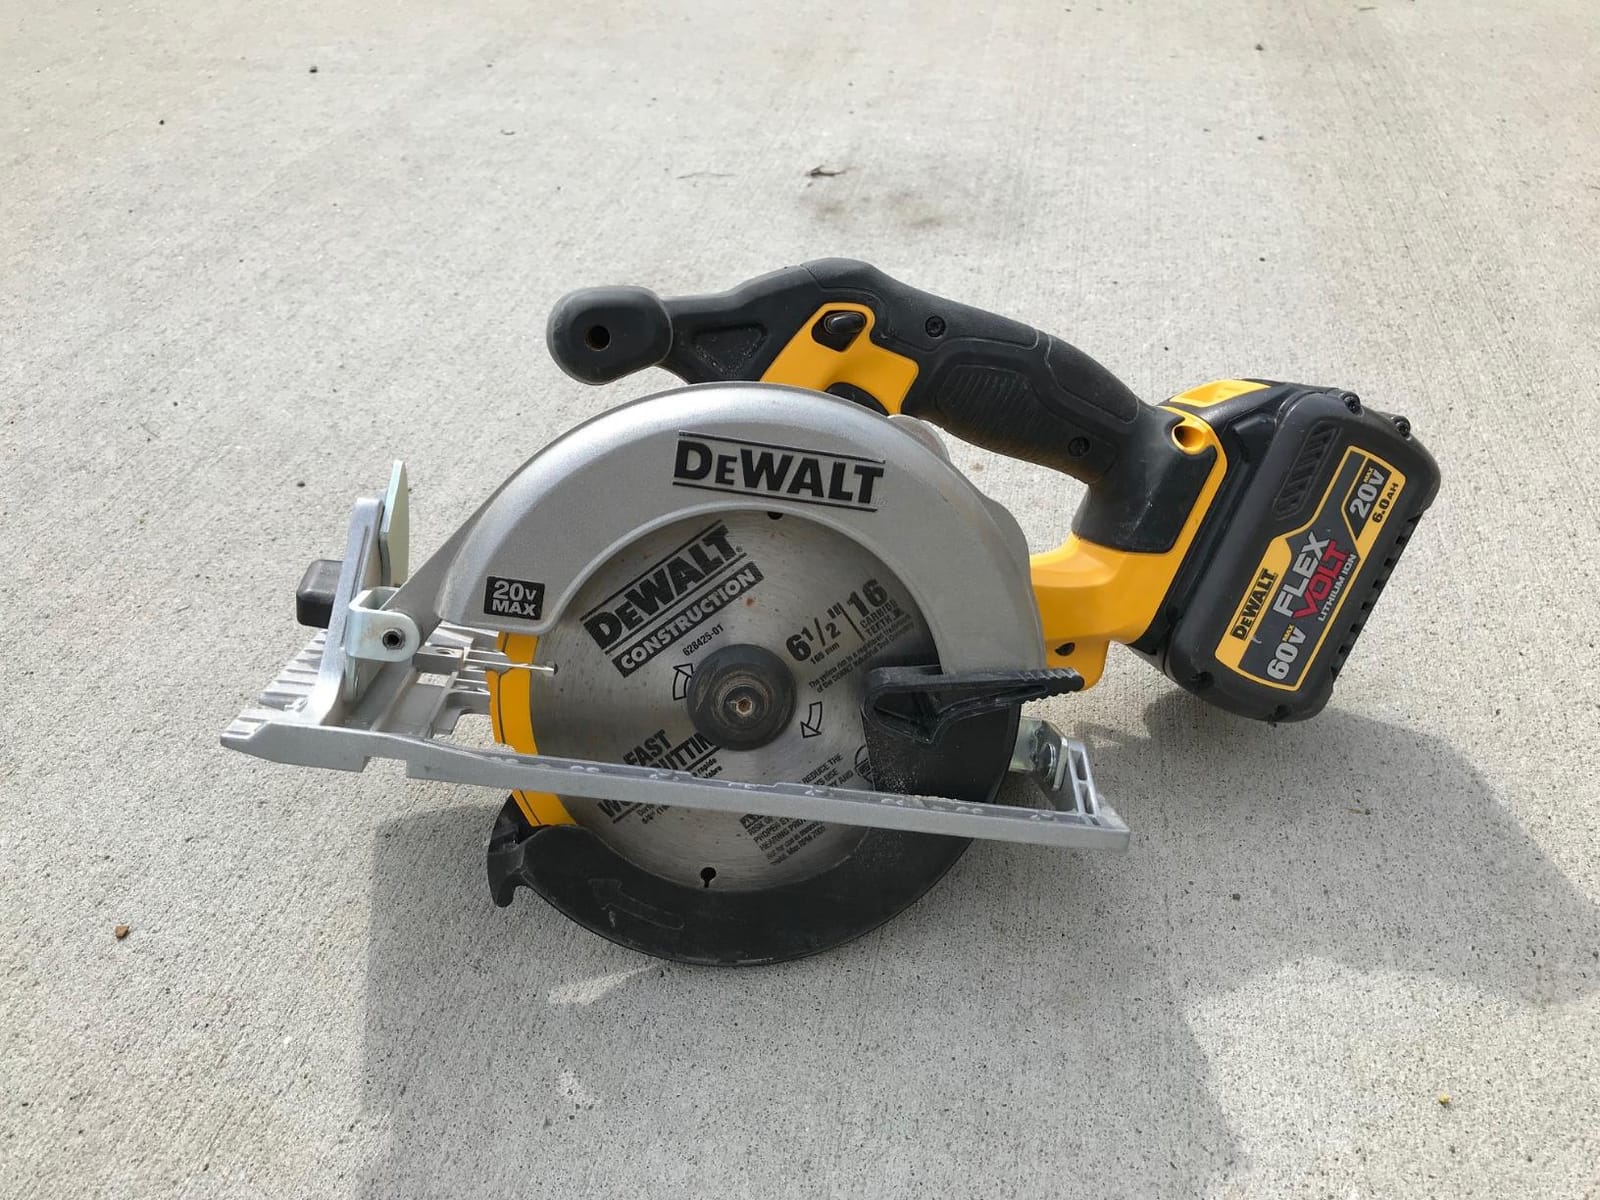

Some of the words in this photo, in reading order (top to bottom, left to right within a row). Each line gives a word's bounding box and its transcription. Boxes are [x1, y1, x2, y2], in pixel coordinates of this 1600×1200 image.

[1350, 469, 1384, 518] 20V
[847, 579, 887, 617] 16
[1272, 531, 1330, 618] FLEX
[1293, 540, 1349, 619] VOLT
[1318, 576, 1345, 621] LITHIUM
[1341, 553, 1357, 578] ION
[492, 598, 536, 616] MAX
[620, 568, 756, 635] CONSTRUCTION
[1267, 628, 1306, 680] 60V
[623, 728, 671, 767] FAST
